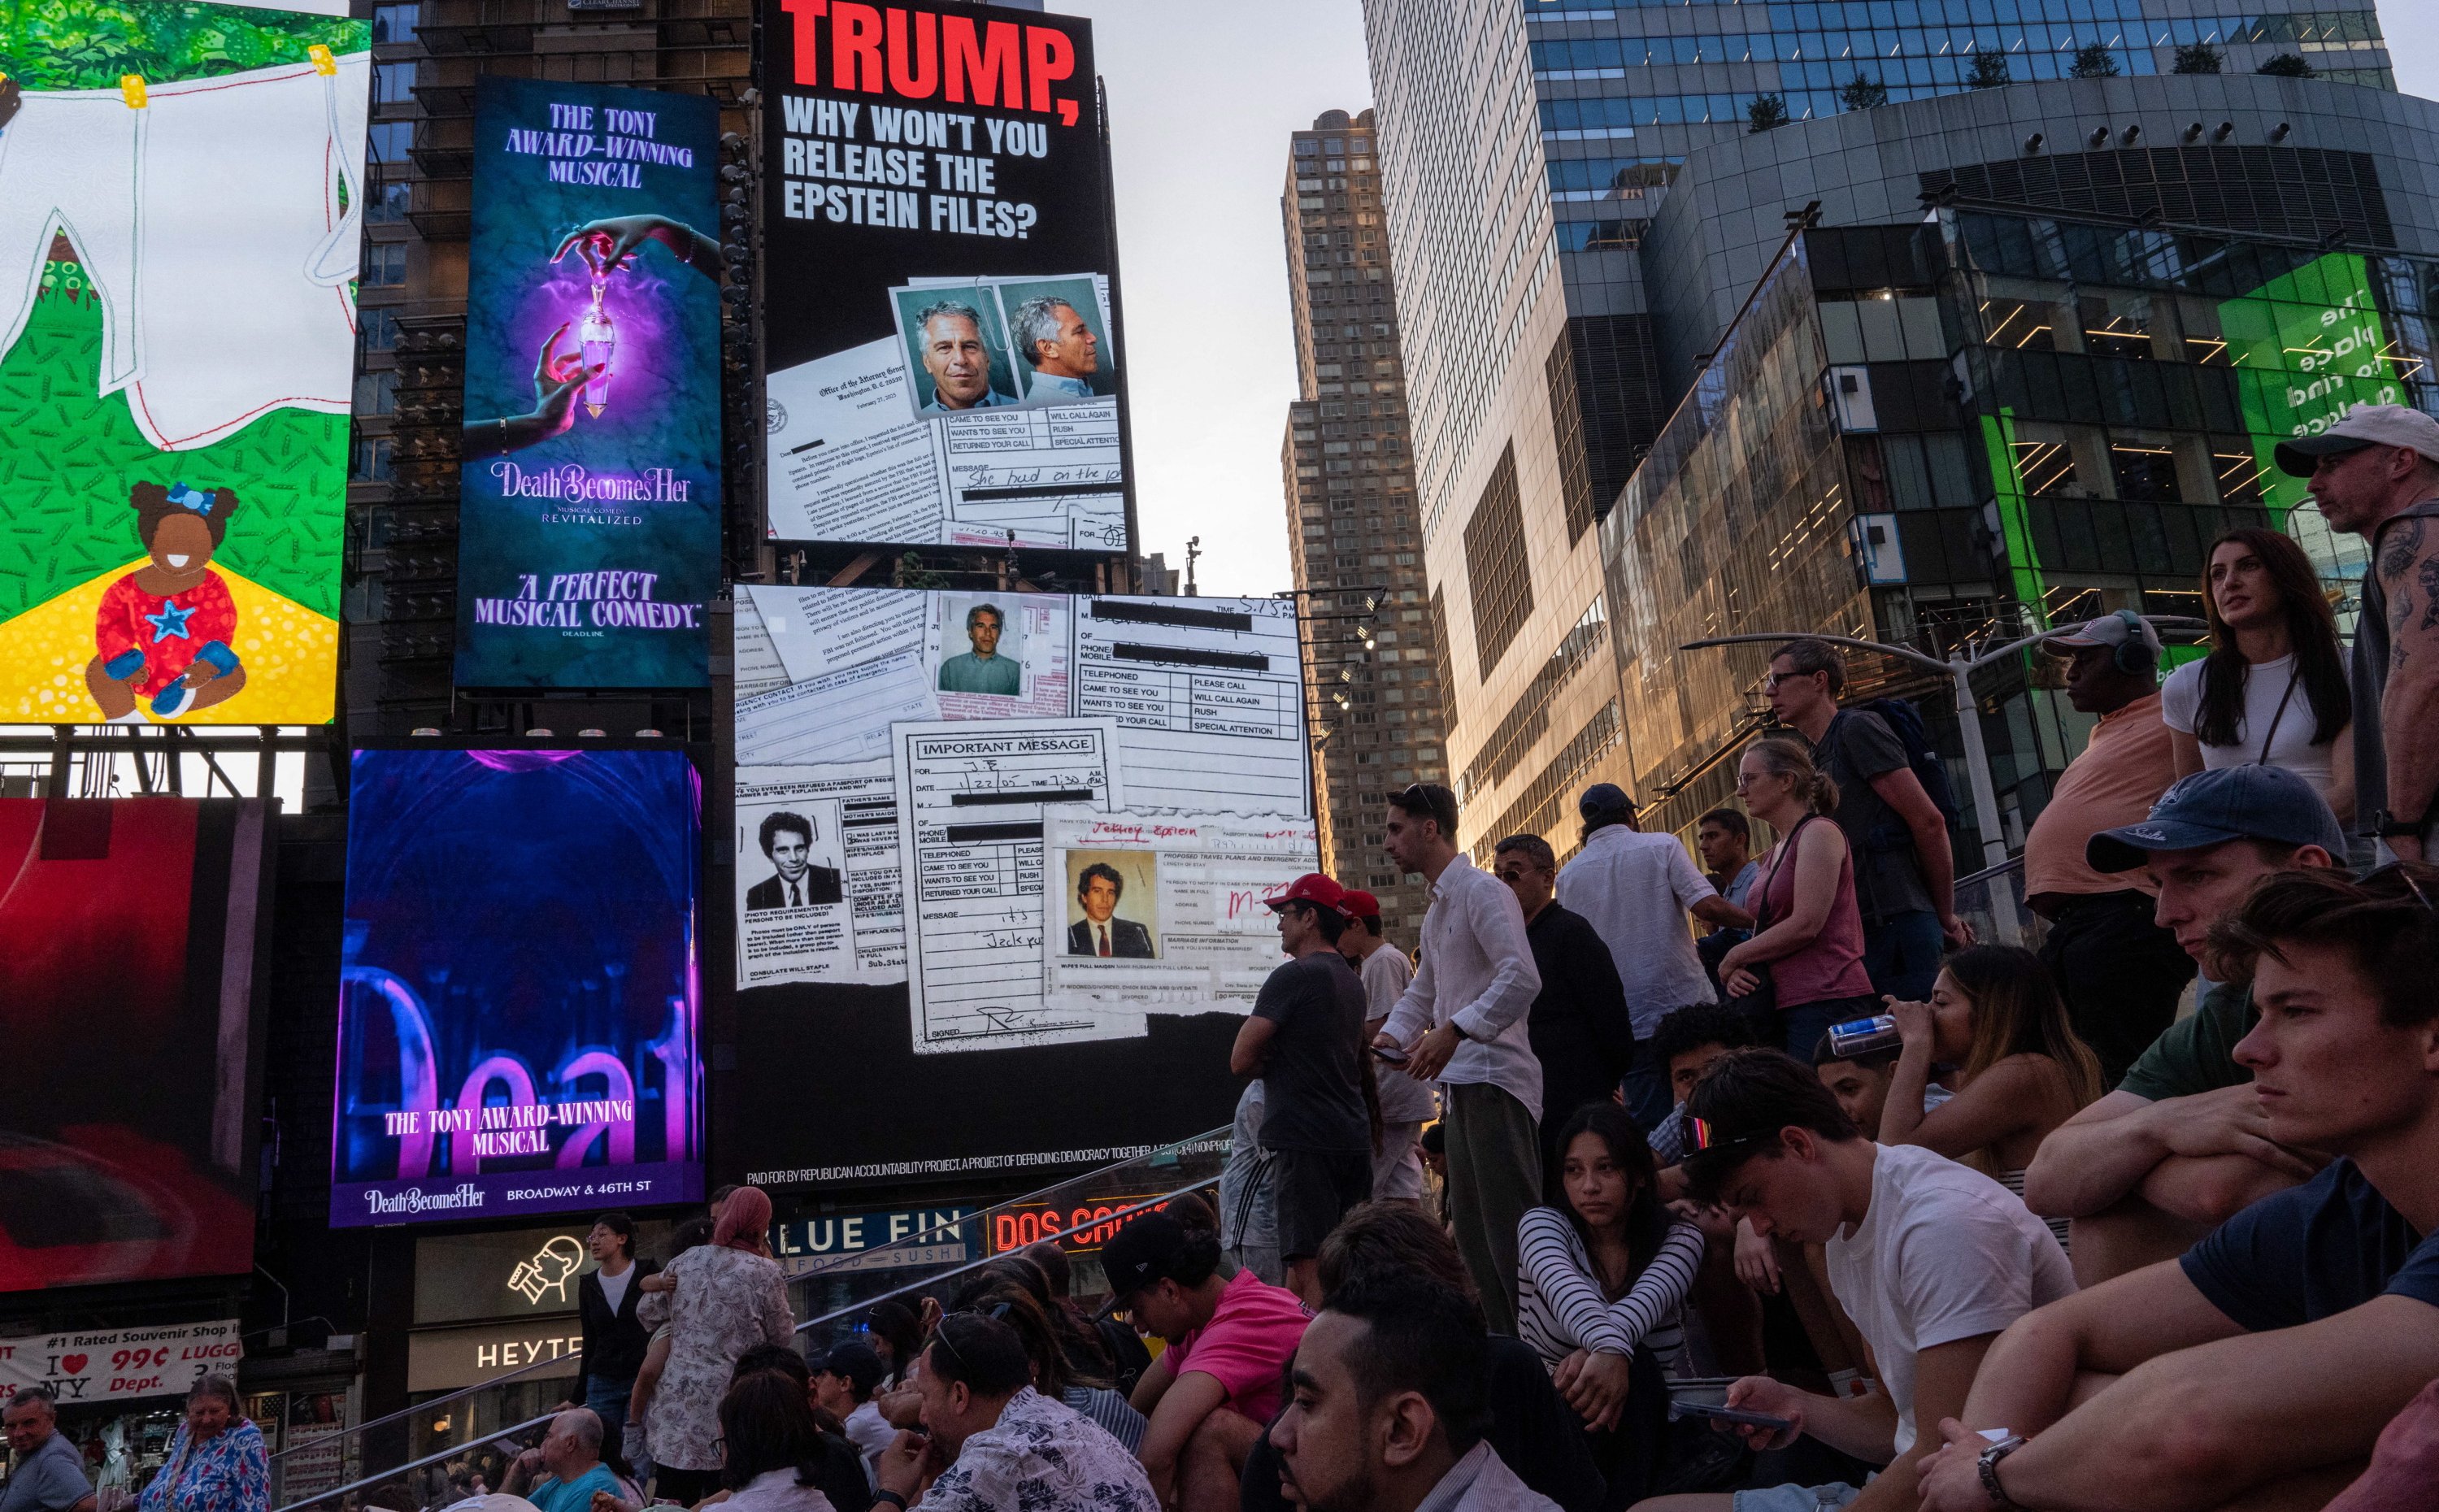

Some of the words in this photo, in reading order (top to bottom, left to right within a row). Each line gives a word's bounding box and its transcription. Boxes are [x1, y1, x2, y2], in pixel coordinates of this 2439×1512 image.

[780, 0, 1079, 127] TRUMP,
[550, 103, 593, 130] THE
[605, 109, 656, 138] TONY
[782, 95, 859, 138] WHY
[871, 105, 976, 151] WON'T
[985, 118, 1047, 158] YOU
[505, 128, 693, 167] AWARD-WINNING
[783, 137, 926, 188] RELEASE
[936, 154, 995, 194] THE
[549, 161, 641, 189] MUSICAL
[784, 180, 919, 230] EPSTEIN
[931, 196, 1037, 239] FILES?
[819, 386, 839, 398] Office
[841, 380, 849, 391] of
[849, 379, 859, 389] the
[859, 371, 887, 387] Attorney
[885, 376, 903, 386] 20530
[856, 401, 877, 410] February
[1050, 412, 1068, 420] WILL
[1069, 411, 1088, 419] CALL
[1089, 411, 1111, 419] AGAIN
[951, 428, 978, 437] WANTS
[1054, 437, 1085, 445] SPECIAL
[953, 441, 990, 450] RETURNED
[952, 464, 989, 472] MESSAGE
[491, 462, 561, 498] Death
[561, 463, 650, 503] Becomes
[644, 467, 691, 502] Her
[967, 469, 994, 488] She
[1076, 467, 1099, 479] the
[541, 514, 642, 525] REVITALIZED
[518, 574, 537, 600] "A
[548, 571, 658, 602] PERFECT
[475, 598, 581, 628] MUSICAL
[591, 601, 702, 628] COMEDY."
[1080, 645, 1112, 654] PHONE/
[1080, 653, 1111, 661] MOBILE
[1083, 669, 1138, 681] TELEPHONED
[1083, 684, 1107, 693] CAME
[1122, 687, 1139, 695] SEE
[1141, 689, 1159, 697] YOU
[1194, 679, 1225, 689] PLEASE
[1228, 682, 1247, 690] CALL
[1082, 698, 1113, 708] WANTS
[1114, 701, 1126, 709] TO
[1128, 702, 1145, 710] SEE
[1146, 703, 1164, 712] YOU
[1194, 693, 1214, 702] WILL
[1215, 695, 1234, 703] CALL
[1236, 696, 1260, 706] AGAIN
[1194, 707, 1217, 716] RUSH
[1194, 722, 1228, 732] SPECIAL
[1229, 724, 1272, 735] ATTENTION
[923, 741, 1013, 755] IMPORTANT
[1018, 739, 1089, 752] MESSAGE
[923, 850, 971, 859] TELEPHONED
[957, 862, 972, 870] SEE
[923, 911, 959, 920] MESSAGE
[385, 1111, 420, 1136] THE
[428, 1108, 474, 1132] TONY
[479, 1099, 633, 1130] AWARD-WINNING
[472, 1130, 550, 1156] MUSICAL
[747, 1172, 767, 1185] PAID
[768, 1171, 786, 1184] FOR
[787, 1170, 800, 1183] BY
[800, 1166, 853, 1181] REPUBLICAN
[854, 1161, 924, 1178] ACCOUNTABILITY
[924, 1158, 962, 1172] PROJECT,
[962, 1158, 968, 1170] A
[968, 1155, 1004, 1170] PROJECT
[1004, 1154, 1015, 1167] OF
[1016, 1151, 1060, 1167] DEFENDING
[1061, 1148, 1110, 1163] DEMOCRACY
[1111, 1145, 1151, 1160] TOGETHER
[364, 1188, 406, 1214] Death
[406, 1186, 461, 1214] Becomes
[458, 1183, 485, 1207] Her
[506, 1184, 580, 1201] BROADWAY
[585, 1184, 593, 1195] &
[598, 1182, 633, 1195] 46TH
[636, 1180, 651, 1193] ST
[780, 1217, 864, 1253] LUE
[889, 1210, 959, 1244] FIN
[996, 1210, 1060, 1251] DOS
[894, 1247, 961, 1263] SUSHI
[46, 1337, 67, 1349] #1
[73, 1334, 118, 1346] Rated
[122, 1328, 189, 1343] Souvenir
[193, 1326, 228, 1337] Shop
[46, 1355, 60, 1376] I
[111, 1346, 170, 1371] 99¢
[39, 1377, 91, 1400] NY
[109, 1375, 163, 1393] Dept.
